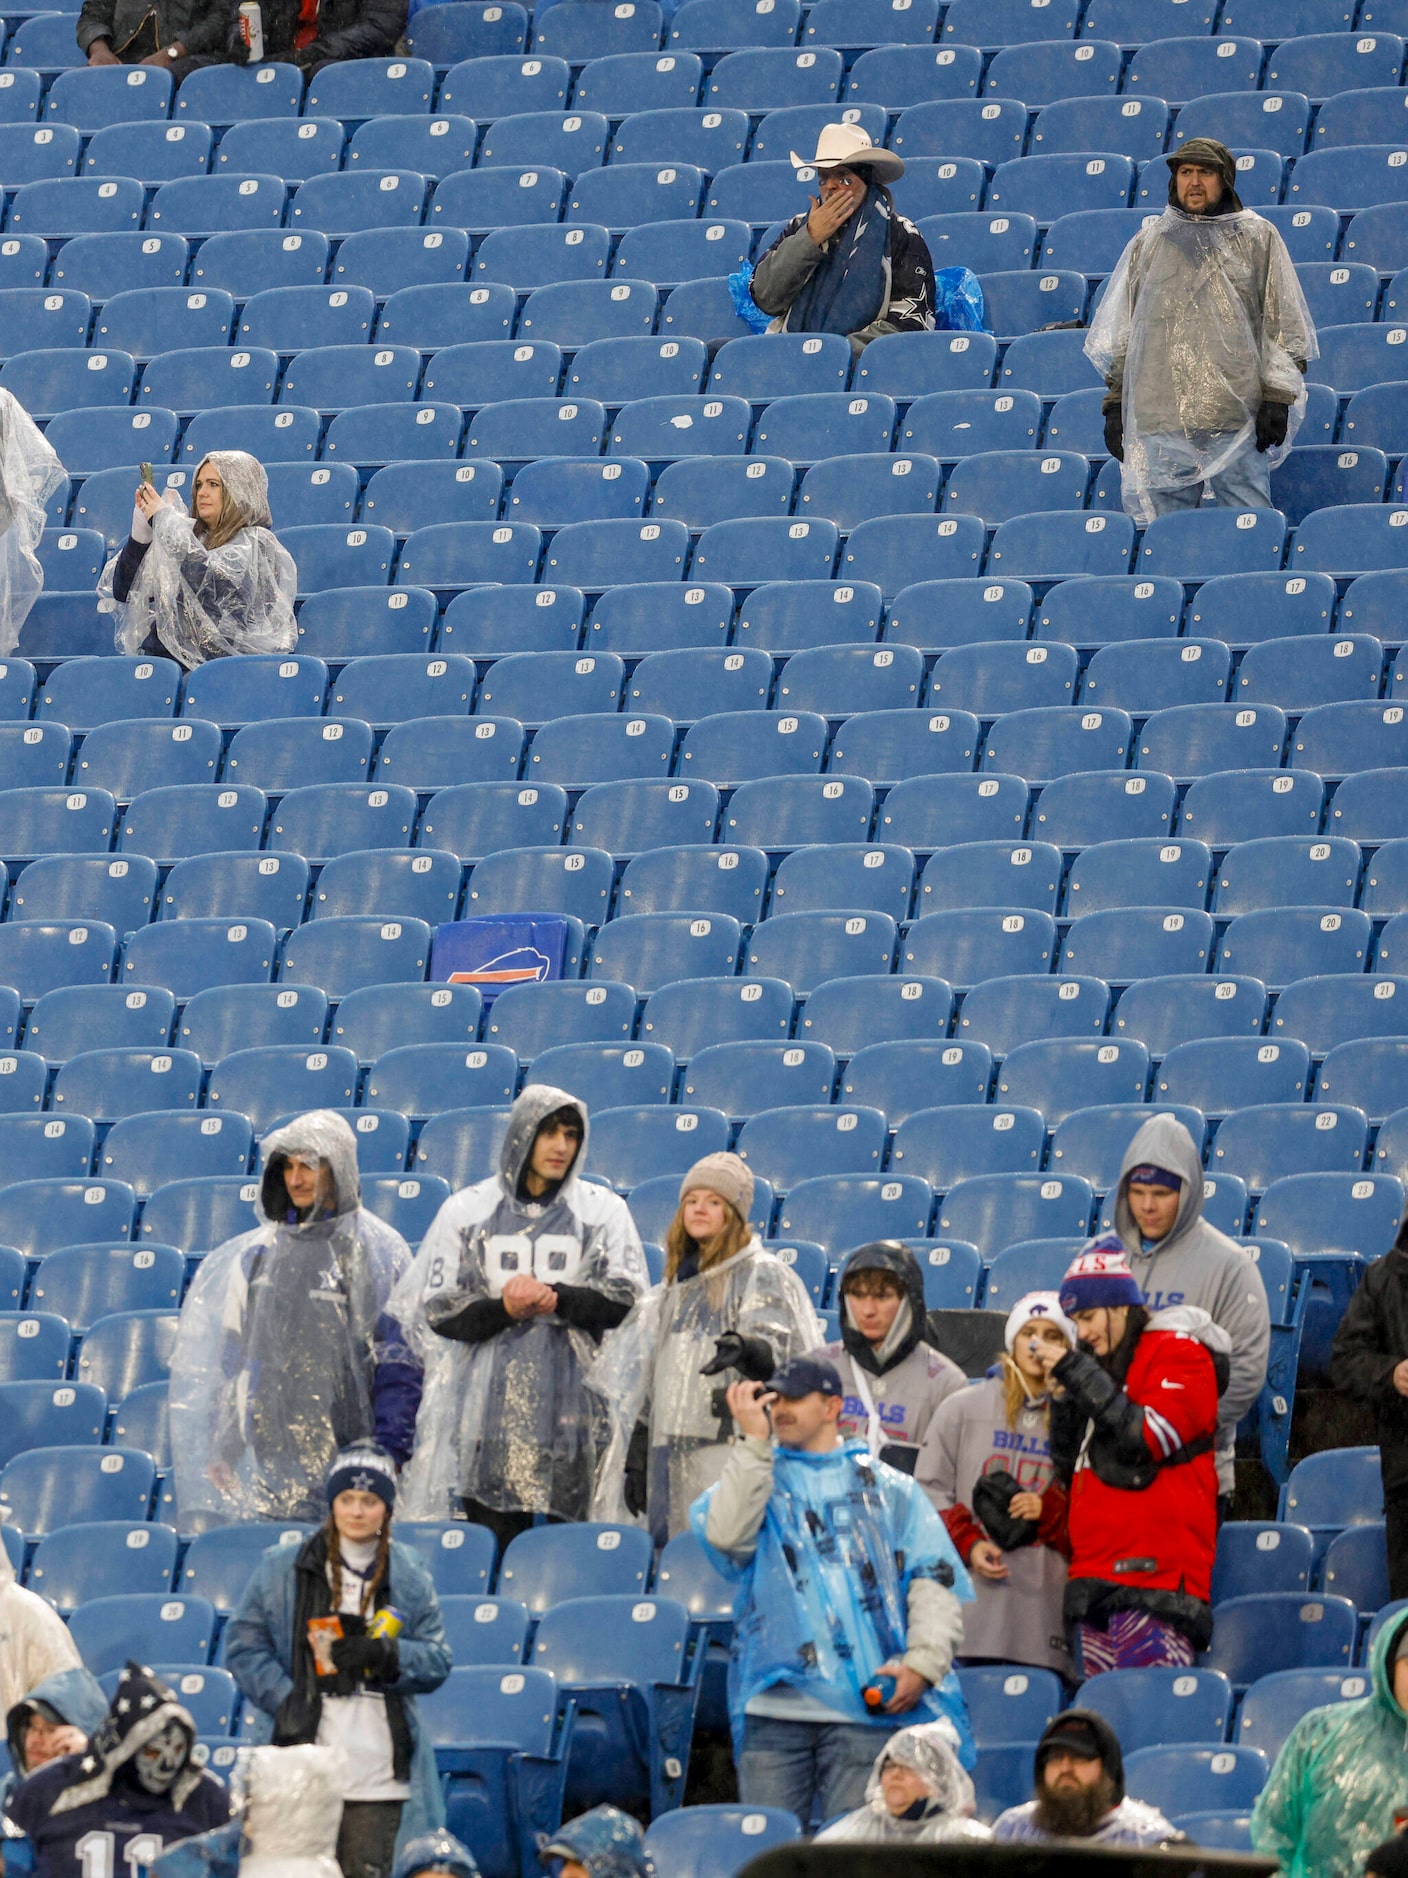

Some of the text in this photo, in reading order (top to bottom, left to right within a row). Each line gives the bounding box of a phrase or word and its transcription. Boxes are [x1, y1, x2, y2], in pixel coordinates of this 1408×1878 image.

[1393, 155, 1402, 165] 13
[943, 167, 952, 177] 10
[1092, 162, 1100, 172] 11
[1297, 215, 1306, 225] 13
[1336, 272, 1344, 281] 14
[709, 405, 717, 415] 11
[854, 402, 863, 412] 12
[1047, 461, 1056, 471] 14
[1343, 456, 1353, 466] 16
[461, 469, 470, 479] 10
[897, 464, 906, 474] 13
[944, 524, 952, 533] 14
[1092, 519, 1100, 530] 15
[353, 534, 362, 544] 10
[1140, 586, 1149, 596] 16
[1291, 582, 1301, 593] 17
[542, 594, 551, 604] 12
[840, 590, 848, 600] 14
[1340, 644, 1349, 654] 18
[730, 658, 739, 668] 14
[433, 664, 442, 674] 12
[1242, 713, 1251, 724] 18
[1389, 711, 1399, 721] 19
[784, 721, 793, 731] 15
[935, 719, 944, 729] 16
[1087, 717, 1097, 728] 17
[178, 729, 186, 738] 11
[329, 727, 338, 738] 12
[481, 727, 490, 737] 13
[675, 789, 684, 799] 15
[829, 785, 839, 795] 16
[1017, 851, 1027, 862] 18
[1315, 847, 1325, 858] 20
[571, 857, 579, 868] 15
[697, 923, 706, 933] 16
[1009, 919, 1019, 929] 18
[1169, 918, 1179, 928] 19
[1326, 918, 1336, 928] 20
[908, 986, 917, 996] 18
[1065, 986, 1075, 997] 19
[1221, 986, 1231, 997] 20
[132, 995, 142, 1006] 13
[1263, 1048, 1273, 1059] 21
[364, 1119, 373, 1129] 16
[683, 1118, 693, 1128] 18
[51, 1124, 60, 1135] 14
[247, 1188, 256, 1198] 16
[887, 1186, 897, 1197] 20
[1047, 1184, 1056, 1196] 21
[1357, 1185, 1368, 1196] 23
[140, 1255, 149, 1265] 16
